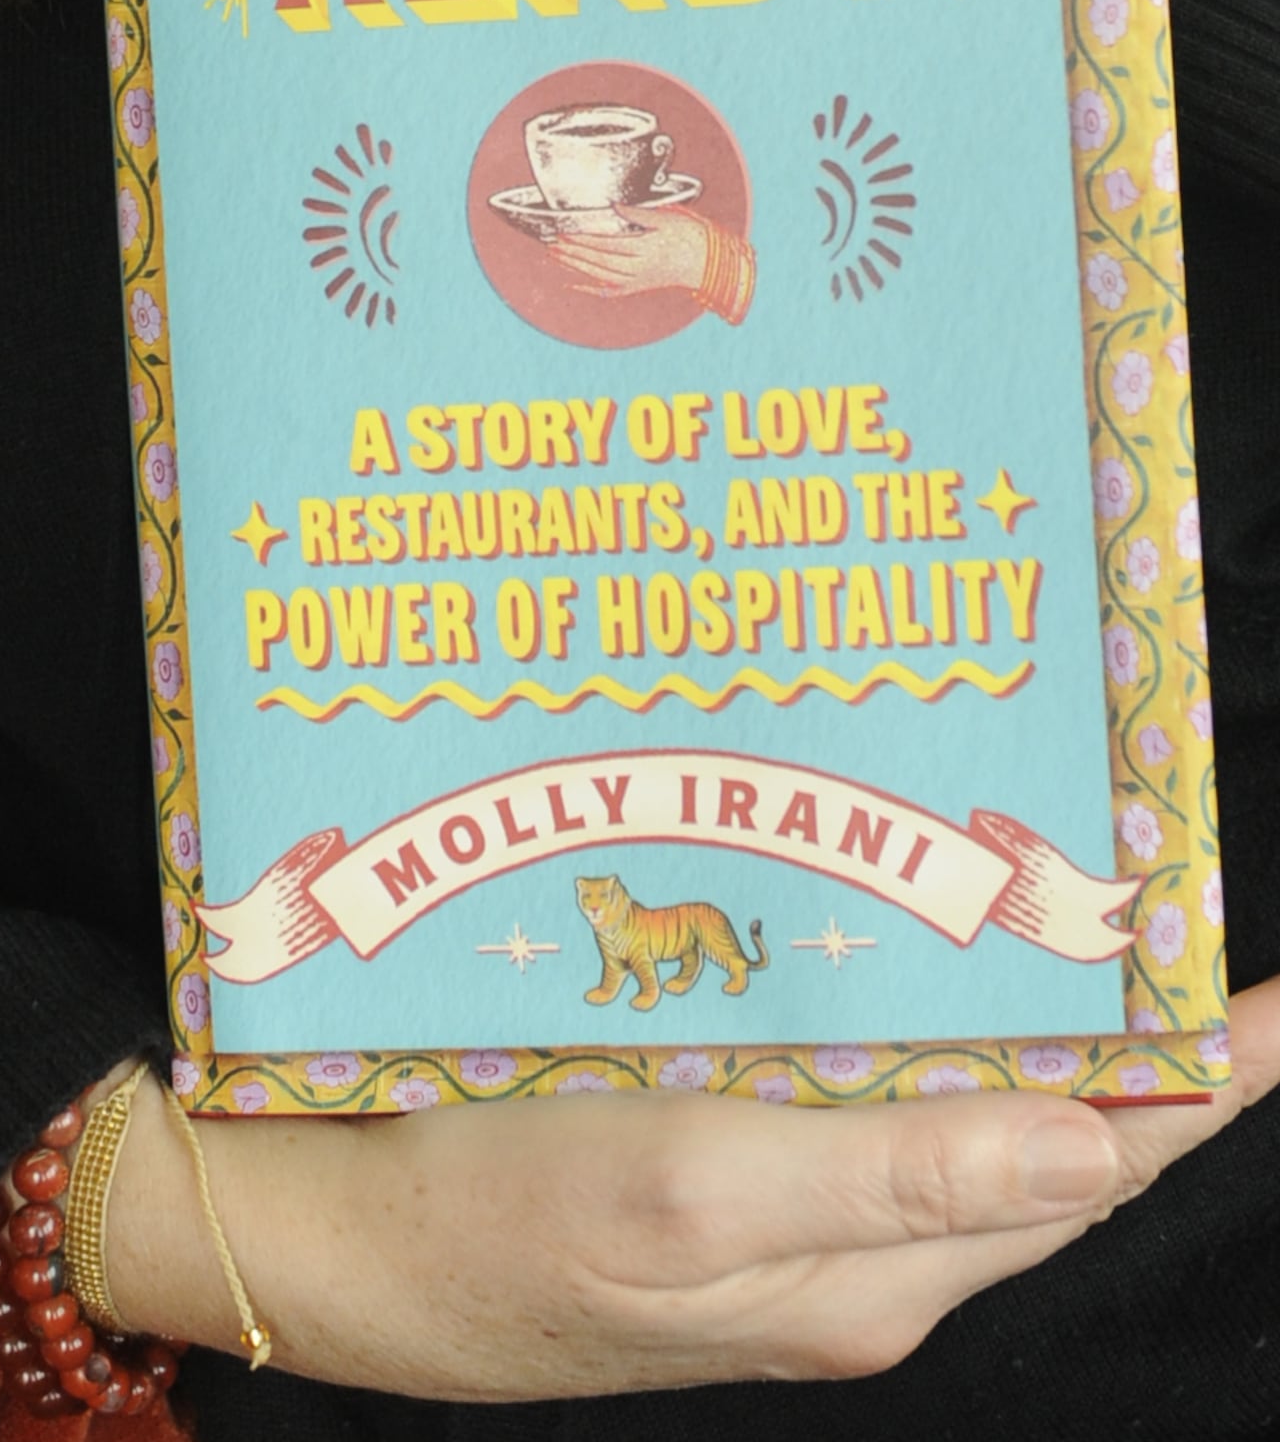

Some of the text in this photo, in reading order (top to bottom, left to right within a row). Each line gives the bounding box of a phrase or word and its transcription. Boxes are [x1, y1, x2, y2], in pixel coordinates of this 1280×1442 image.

[348, 385, 910, 480] A STORY OF LOVE,
[299, 469, 965, 566] RESTAURANTS, AND THE
[244, 558, 1043, 672] POWER OF HOSPITALITY
[371, 774, 936, 908] MOLLY IRANI
